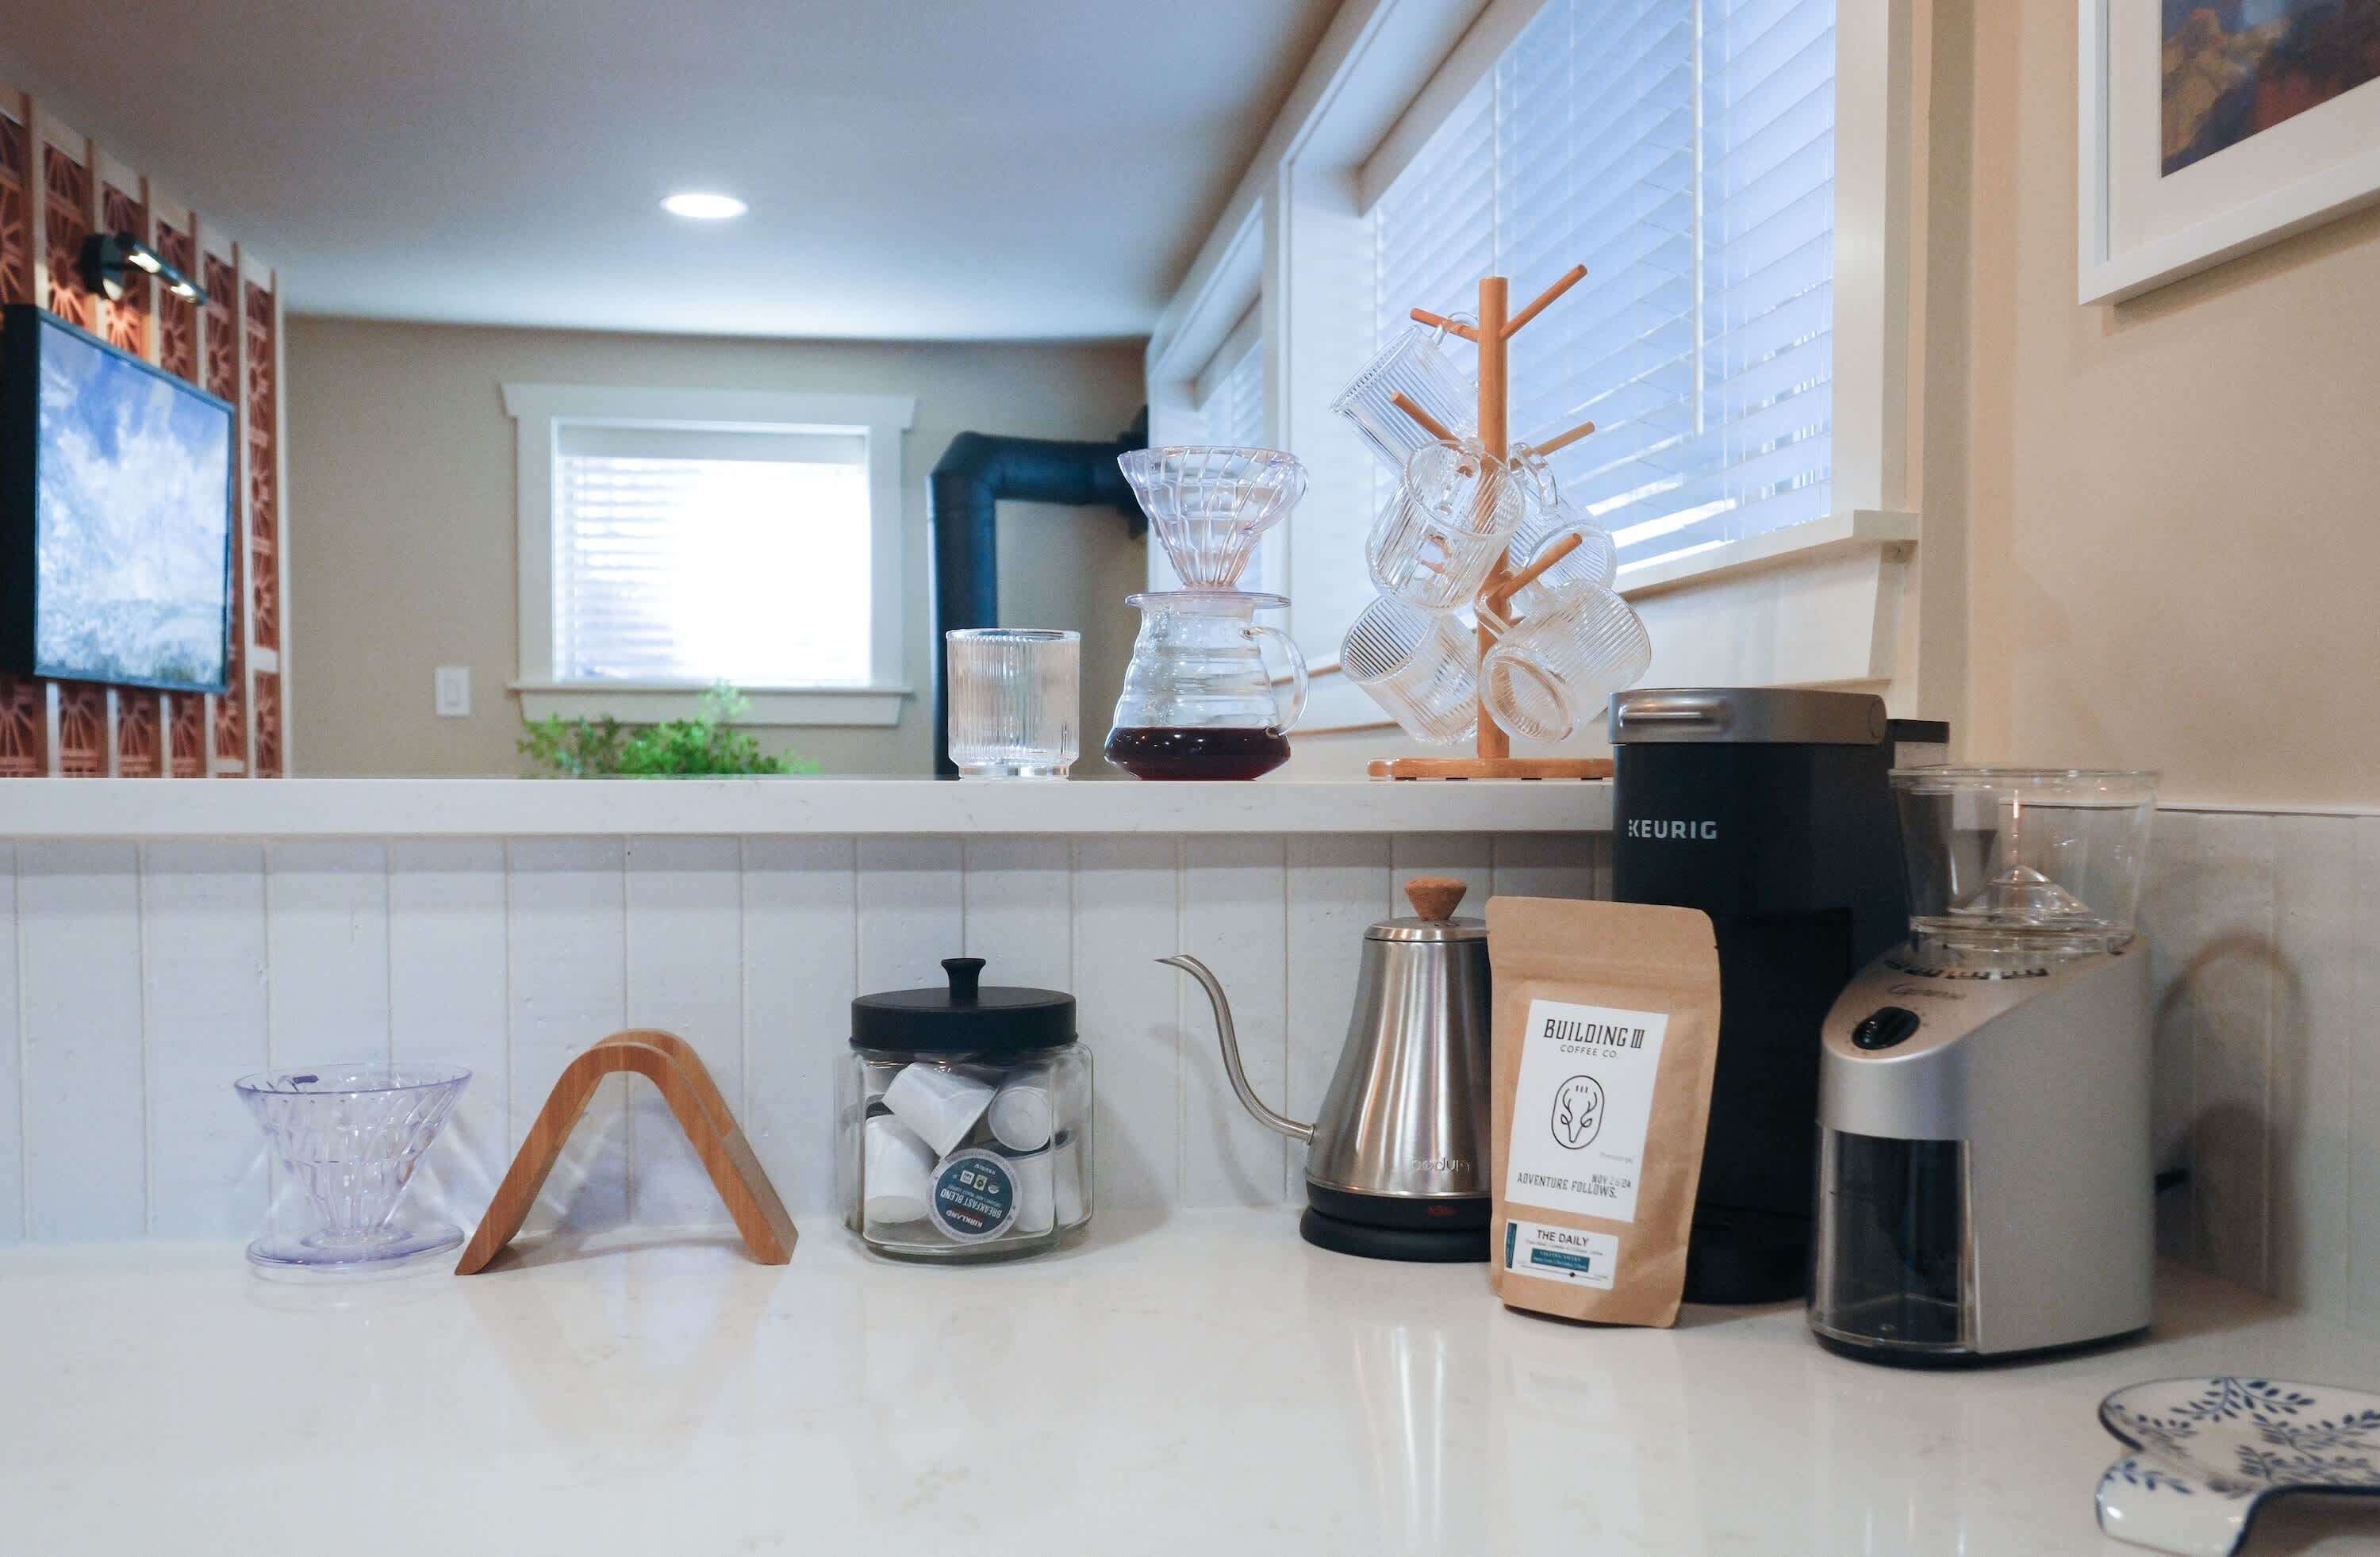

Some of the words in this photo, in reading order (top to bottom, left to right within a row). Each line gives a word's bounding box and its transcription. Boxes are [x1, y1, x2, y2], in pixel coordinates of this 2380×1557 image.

[1628, 819, 1718, 840] KEURIG
[1543, 1018, 1629, 1048] BUILDING
[1560, 1043, 1599, 1057] COFFEE
[1517, 1171, 1569, 1191] ADVENTURE
[1591, 1173, 1607, 1185] NOV
[940, 1188, 964, 1203] BLEND
[964, 1197, 1003, 1219] BREAKFAST
[946, 1210, 983, 1228] KIRKLAND
[1537, 1229, 1556, 1242] THE
[1558, 1233, 1590, 1247] DAILY
